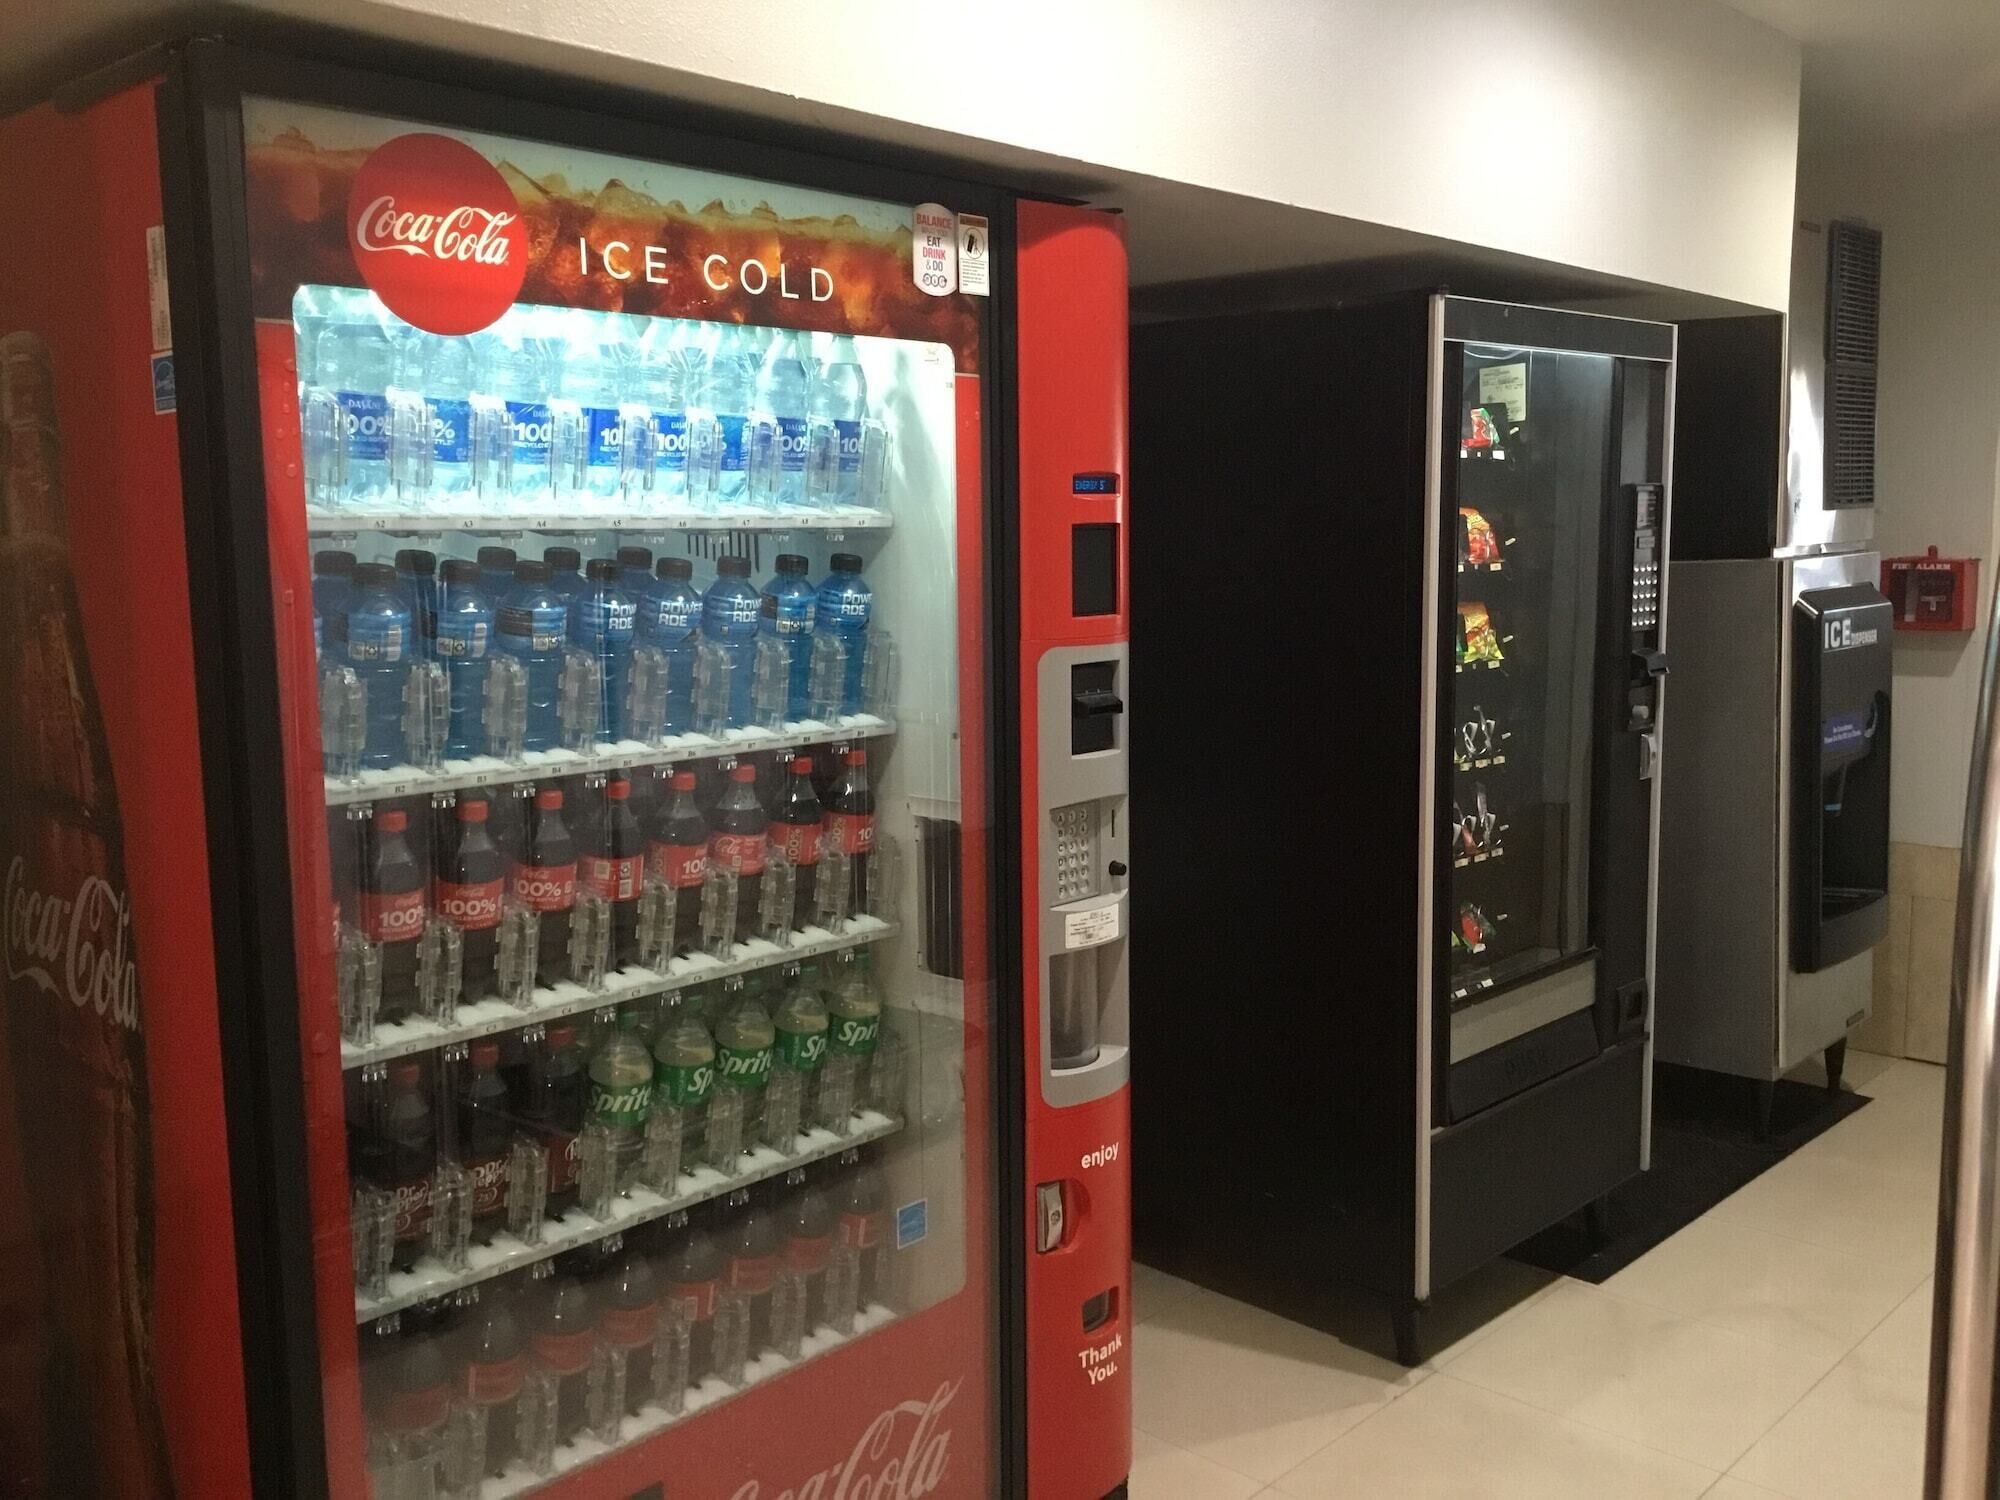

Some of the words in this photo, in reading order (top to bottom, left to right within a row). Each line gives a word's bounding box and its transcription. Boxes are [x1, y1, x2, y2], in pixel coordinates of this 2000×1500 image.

[357, 196, 517, 265] Coca-Cola
[916, 213, 952, 230] BALANCE
[927, 235, 941, 248] EAT
[922, 247, 946, 261] DRINK
[580, 237, 669, 284] ICE
[703, 254, 834, 302] COLD
[932, 260, 943, 272] DO
[513, 422, 552, 442] 100
[656, 433, 688, 451] 100
[610, 604, 637, 617] POW
[733, 610, 757, 623] ADE
[841, 604, 865, 616] ADE
[608, 616, 633, 630] ADE
[659, 613, 687, 627] ADE
[1824, 618, 1851, 649] ICE
[682, 857, 706, 874] 100
[443, 897, 497, 916] 100%
[4, 855, 138, 1032] Coca-Cola
[716, 1050, 772, 1075] Sprit
[1081, 1142, 1119, 1168] enjoy
[1079, 1334, 1122, 1368] Thank
[1088, 1361, 1118, 1385] You.
